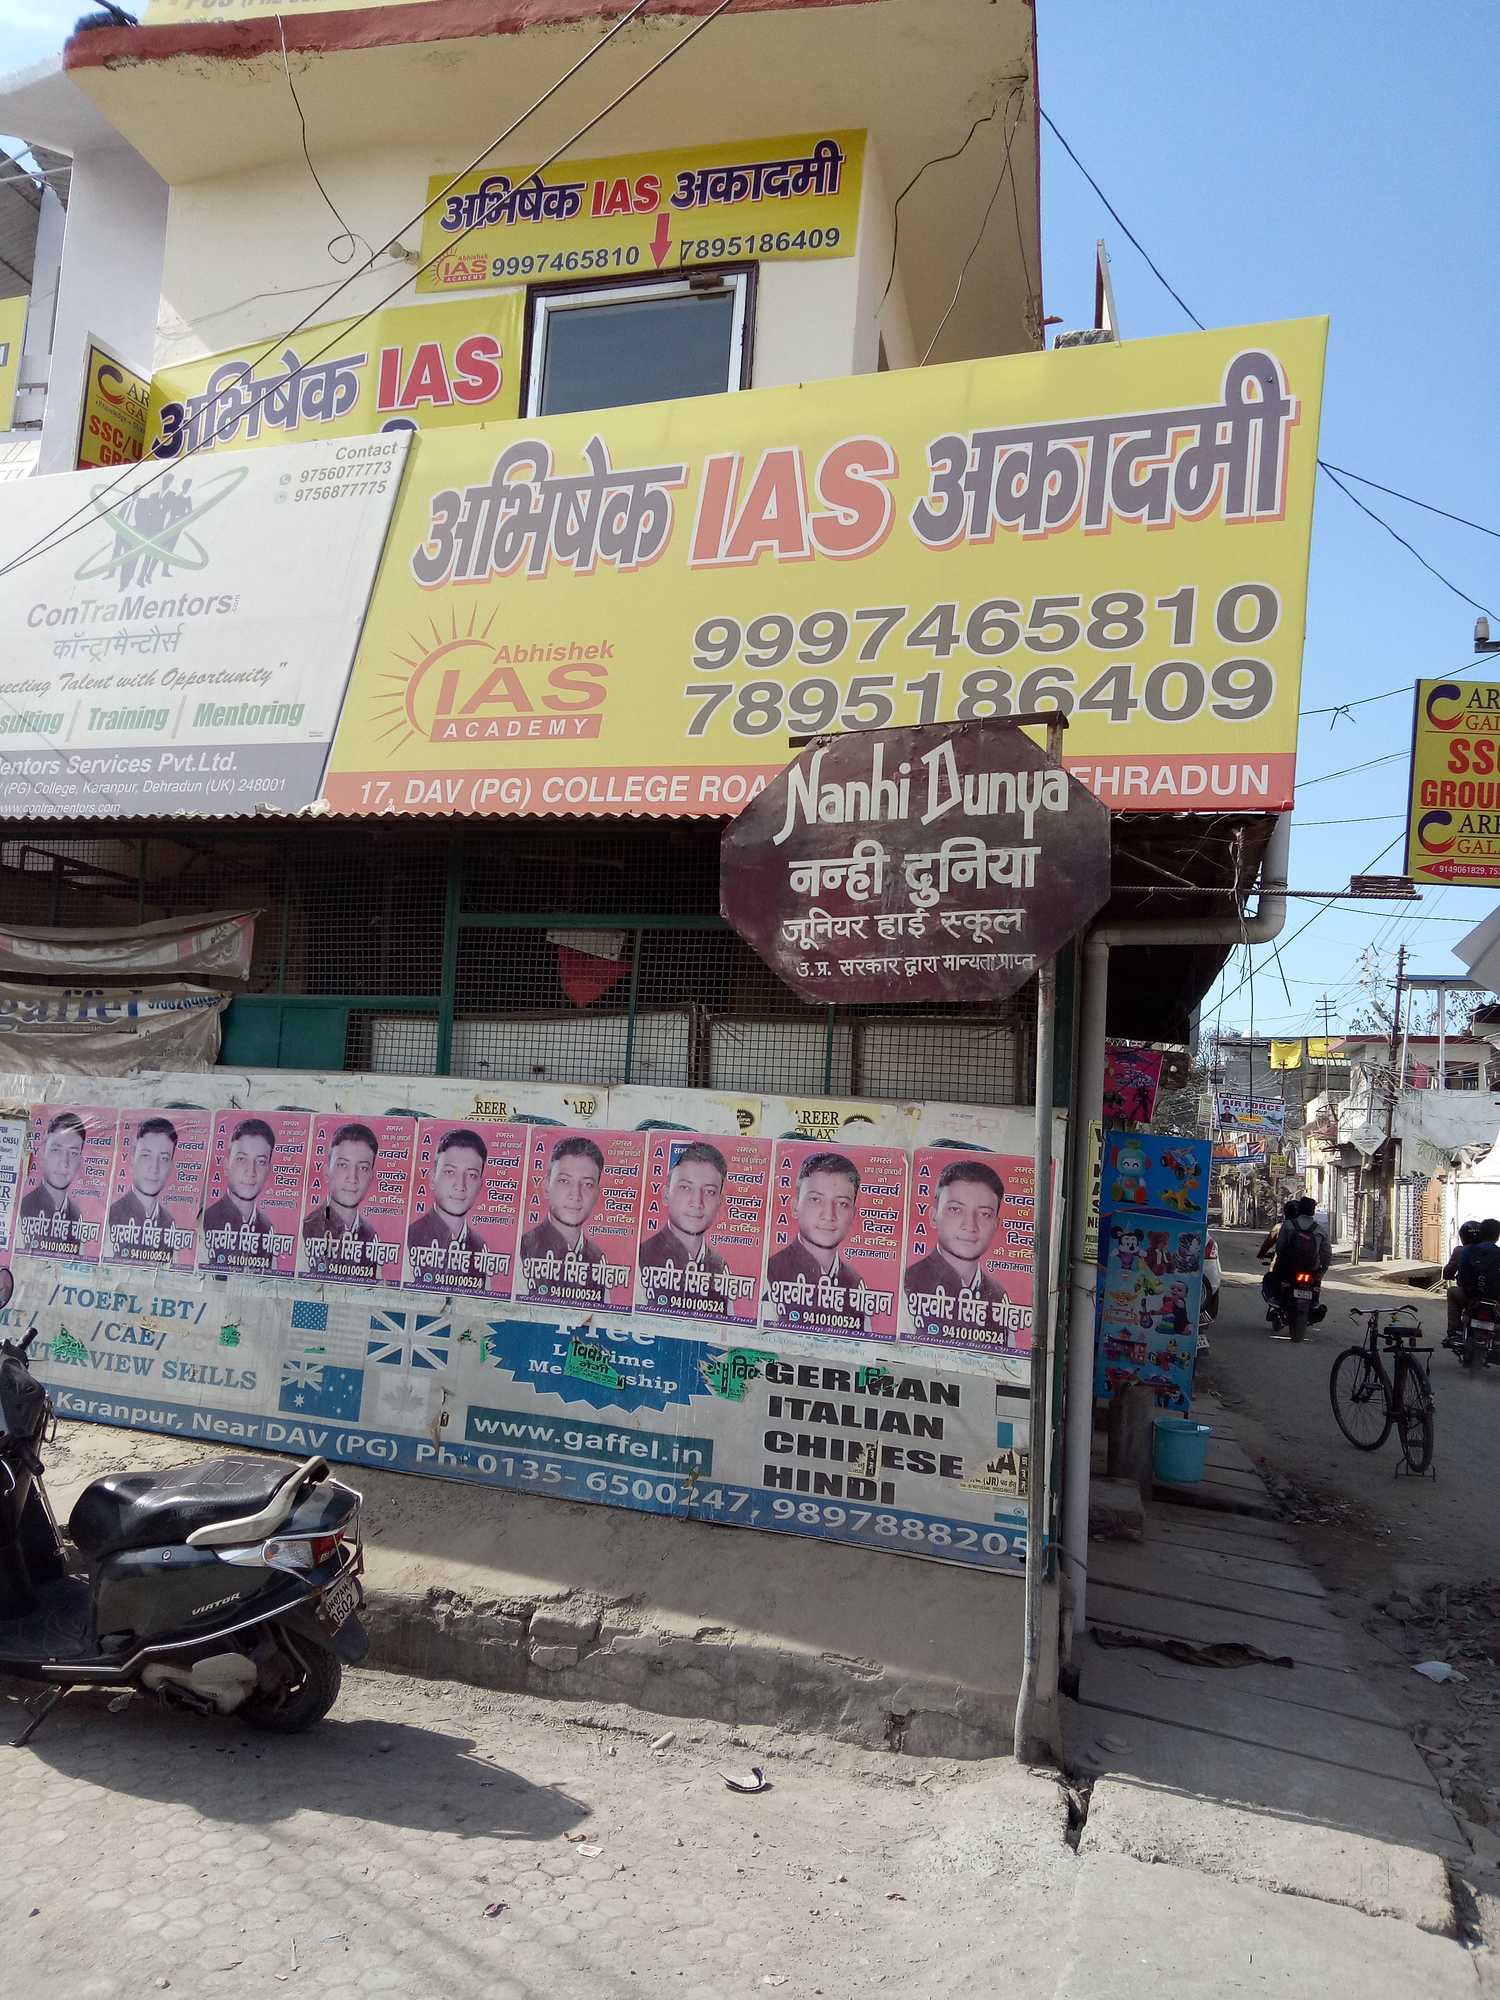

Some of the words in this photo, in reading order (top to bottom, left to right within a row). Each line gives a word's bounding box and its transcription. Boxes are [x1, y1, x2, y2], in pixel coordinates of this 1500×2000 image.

[440, 173, 586, 233] अभिषेक
[591, 174, 661, 217] IAS
[670, 138, 846, 211] अकादमी
[444, 260, 487, 276] IAS
[492, 246, 640, 278] 9997465810
[681, 227, 840, 259] 7895186409
[152, 348, 368, 459] अभिषेक
[376, 335, 501, 412] IAS
[335, 441, 397, 461] Contact
[299, 461, 392, 483] 9756077773
[410, 434, 690, 592] अभिषेक
[687, 436, 899, 570] IAS
[909, 349, 1300, 552] अकादमी
[294, 481, 387, 502] 9756877775
[27, 594, 233, 628] ConTraMentors
[692, 582, 1281, 674] 9997465810
[493, 640, 615, 666] Abhishek
[59, 673, 112, 692] Talent
[116, 668, 156, 689] with
[161, 665, 272, 689] Opportunity
[436, 663, 610, 716] IAS
[682, 657, 1277, 739] 7895186409
[88, 705, 170, 731] Training
[192, 700, 305, 729] Mentoring
[443, 718, 588, 739] ACADEMY
[0, 756, 61, 775] entors
[66, 753, 152, 775] Services
[1448, 738, 1500, 775] SS
[4, 781, 32, 796] (PG)
[143, 779, 202, 793] Dehradun
[205, 778, 235, 795] (UK)
[238, 777, 286, 793] 248001
[360, 782, 395, 810] 17,
[405, 776, 465, 804] DAV
[470, 774, 532, 809] (PG)
[542, 772, 688, 804] COLLEGE
[698, 772, 782, 802] ROA
[1072, 765, 1269, 796] EHRADUN
[772, 742, 912, 846] Nanhi
[921, 740, 1069, 839] Dunya
[1420, 780, 1500, 808] GROU
[1418, 810, 1500, 854] CAR
[1457, 840, 1500, 854] GAL
[788, 839, 891, 900] नन्ही
[904, 836, 1042, 907] दुनिया
[781, 907, 870, 951] जूनियर
[874, 908, 929, 940] हाई
[940, 908, 1026, 945] स्कूल
[839, 959, 903, 976] सरकार
[903, 956, 940, 977] द्वारा
[117, 1122, 131, 1193] ARYAN
[211, 1125, 226, 1198] ARYAN
[311, 1128, 325, 1205] ARYAN
[416, 1133, 432, 1213] ARYAN
[487, 1157, 519, 1168] नववर्ष
[604, 1164, 640, 1177] नववर्ष
[486, 1179, 518, 1190] गणतंत्र
[488, 1189, 513, 1202] दिवस
[528, 1141, 546, 1223] ARYAN
[603, 1188, 636, 1199] गणतंत्र
[647, 1147, 664, 1230] ARYAN
[728, 1172, 764, 1185] नववर्ष
[860, 1184, 900, 1197] नववर्ष
[605, 1200, 632, 1212] दिवस
[725, 1195, 761, 1208] गणतंत्र
[729, 1208, 757, 1221] दिवस
[776, 1157, 792, 1245] ARYAN
[860, 1207, 899, 1221] गणतंत्र
[914, 1164, 930, 1256] ARYAN
[863, 1221, 894, 1235] दिवस
[448, 1239, 470, 1274] सिंह
[563, 1250, 589, 1286] सिंह
[434, 1275, 483, 1289] 9410100524
[550, 1285, 602, 1301] 9410100524
[685, 1259, 711, 1293] सिंह
[671, 1298, 724, 1313] 9410100524
[817, 1275, 846, 1312] सिंह
[958, 1287, 986, 1327] सिंह
[803, 1313, 860, 1330] 9410100524
[942, 1326, 1005, 1345] 9410100524
[162, 1360, 257, 1390] SKILLS
[765, 1362, 961, 1408] GERMAN
[768, 1395, 944, 1441] ITALIAN
[473, 1416, 703, 1466] www.gaffel.in
[56, 1391, 184, 1430] Karanpur,
[192, 1413, 261, 1438] Near
[265, 1424, 329, 1458] DAV
[335, 1432, 399, 1462] (PG)
[772, 1498, 1028, 1559] 9897888205
[763, 1464, 895, 1505] HINDI
